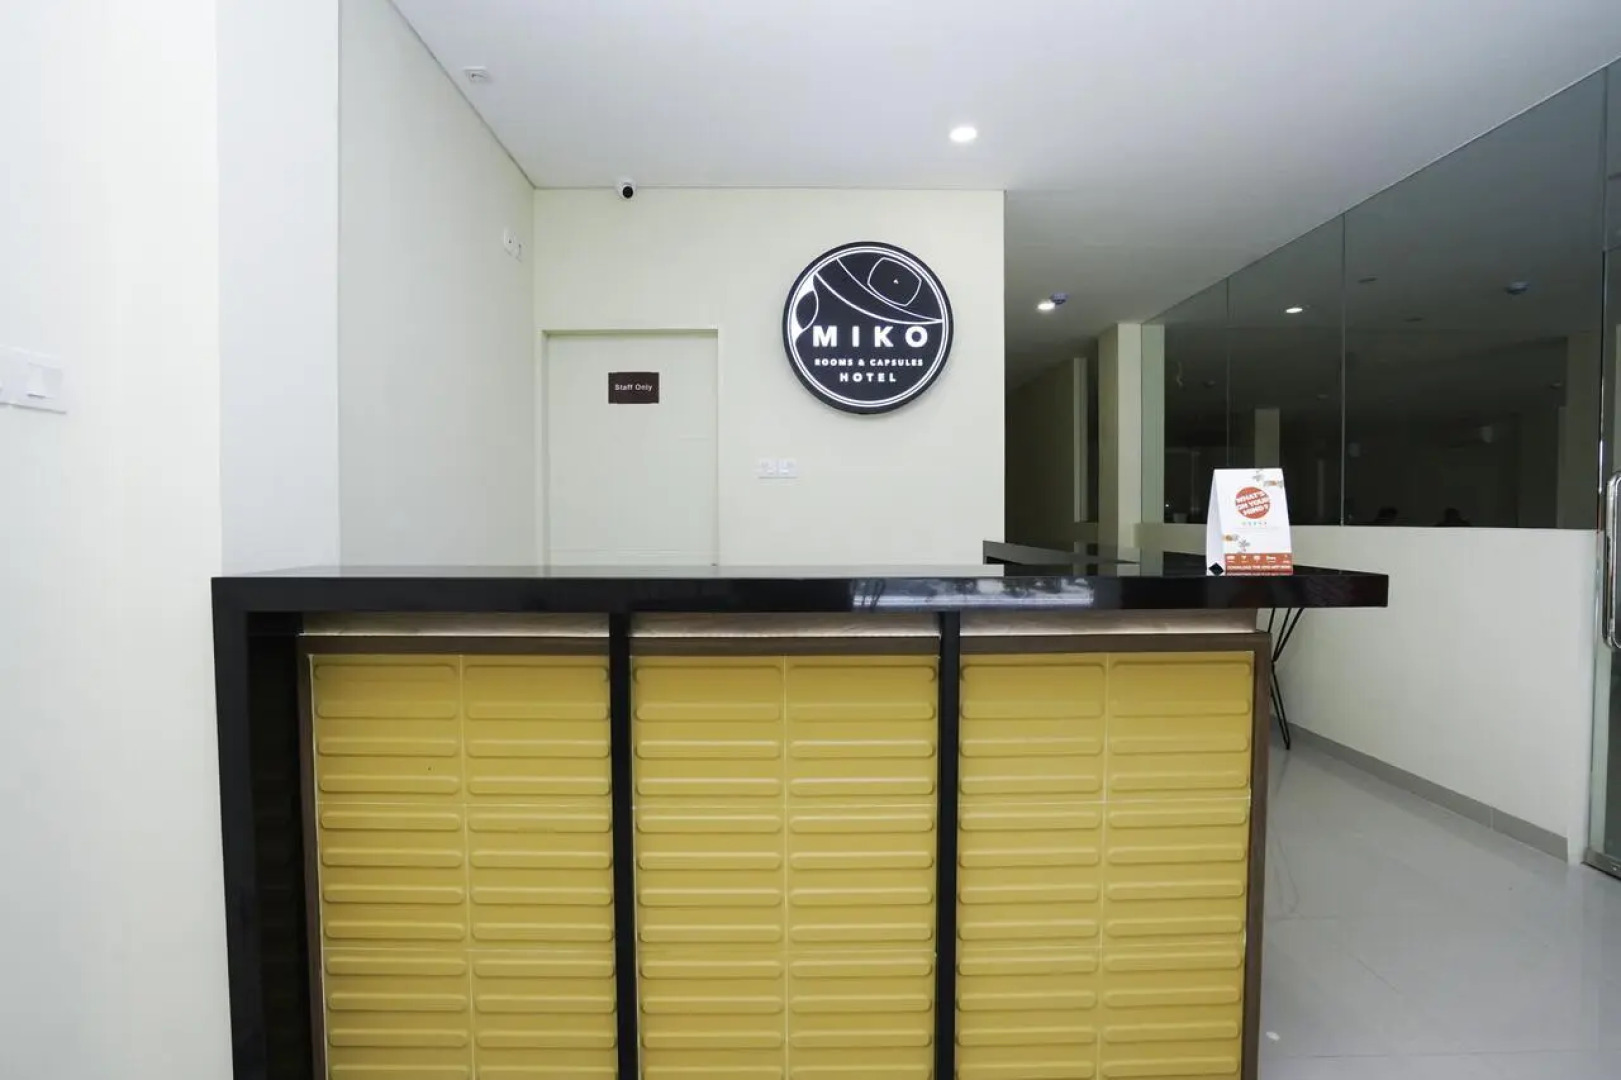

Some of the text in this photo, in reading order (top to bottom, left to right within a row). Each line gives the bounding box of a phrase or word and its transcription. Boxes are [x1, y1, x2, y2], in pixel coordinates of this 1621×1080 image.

[812, 325, 928, 348] MIKO
[814, 358, 923, 367] ROOMS & CAPSULES
[839, 372, 897, 383] HOTEL
[614, 383, 653, 392] Staff Only
